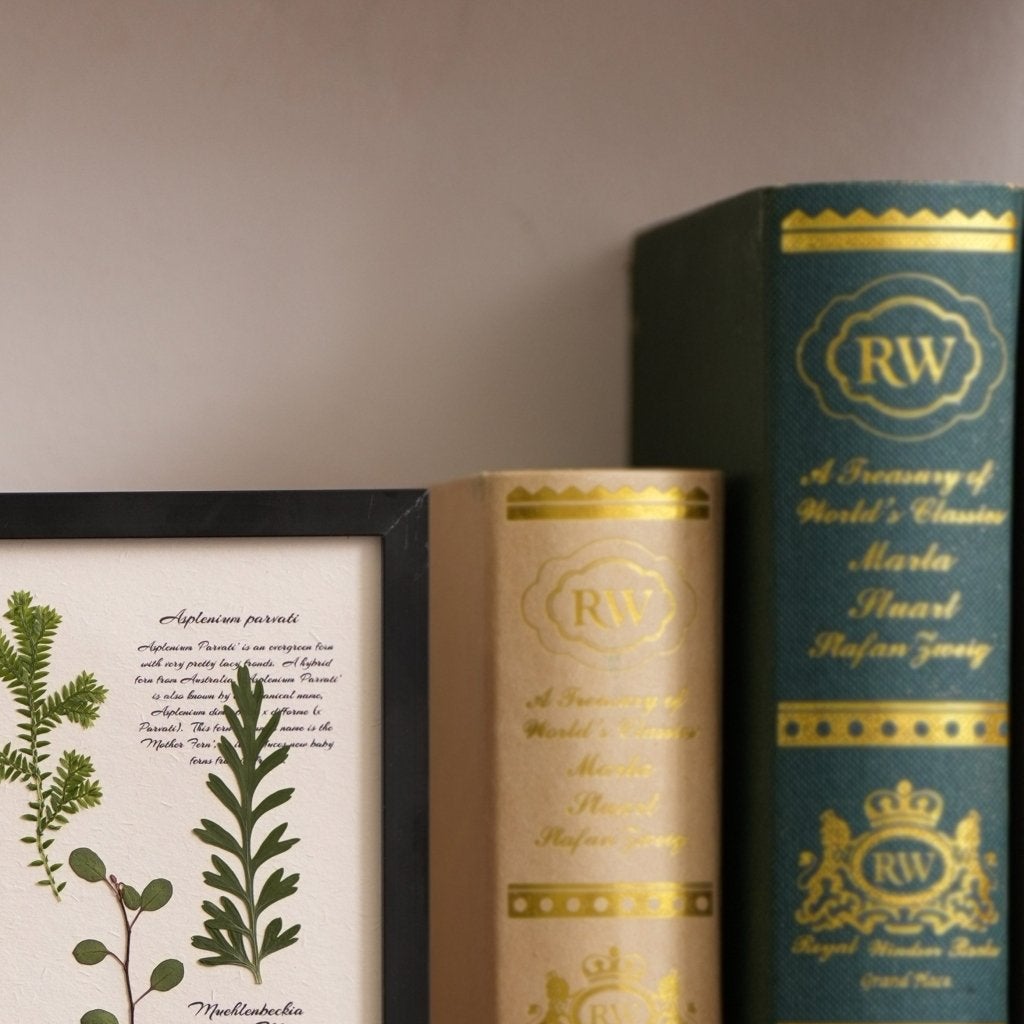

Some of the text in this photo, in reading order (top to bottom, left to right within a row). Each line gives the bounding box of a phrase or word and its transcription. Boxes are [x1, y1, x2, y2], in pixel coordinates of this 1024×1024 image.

[856, 336, 957, 388] RW
[800, 457, 995, 496] A Treasury of
[797, 499, 902, 525] World's
[572, 589, 653, 629] RW
[159, 608, 300, 629] Asplenium parvati
[137, 641, 193, 654] Asplenium
[242, 643, 250, 651] is
[268, 645, 312, 654] evergreen
[314, 641, 334, 652] fern
[140, 656, 333, 671] with very pretty lacy fronds. A hybrid
[134, 675, 153, 685] fern
[156, 675, 177, 685] from
[152, 692, 161, 700] is
[163, 690, 184, 700] also
[187, 689, 215, 700] known
[217, 690, 231, 703] by
[150, 705, 206, 719] Asplenium
[190, 721, 211, 733] This
[307, 724, 317, 732] is
[318, 721, 334, 732] the
[140, 738, 184, 751] Mother
[309, 738, 335, 751] baby
[189, 756, 213, 765] ferns
[874, 852, 935, 885] RW
[187, 1001, 304, 1020] Muehlenbeckia
